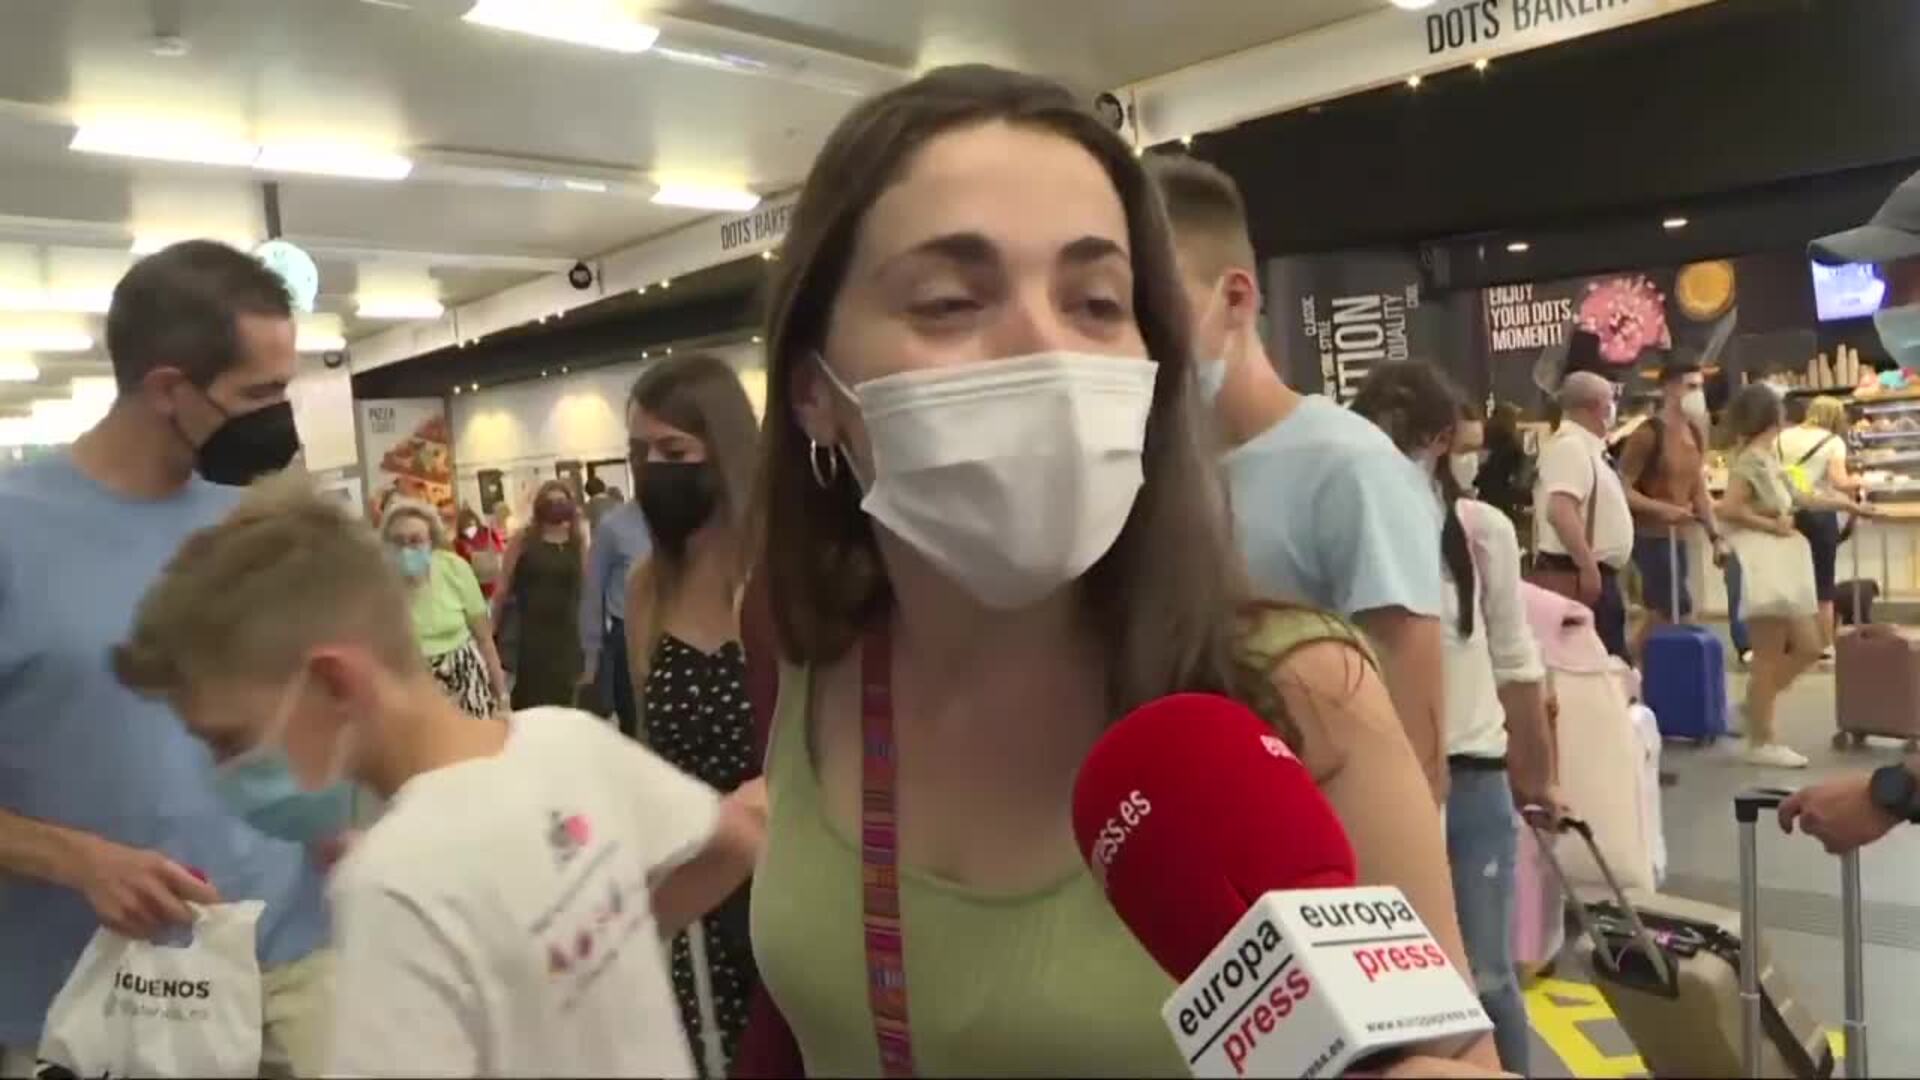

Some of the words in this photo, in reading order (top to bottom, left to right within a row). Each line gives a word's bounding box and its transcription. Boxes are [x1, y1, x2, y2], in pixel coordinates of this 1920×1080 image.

[1426, 0, 1500, 54] DOTS
[1513, 0, 1630, 31] BAK
[720, 216, 751, 250] DOTS
[1489, 283, 1533, 307] ENJOY
[1383, 293, 1409, 361] QUALITY
[1491, 303, 1531, 329] YOUR
[1532, 298, 1571, 324] DOTS
[1493, 323, 1563, 352] MOMENT!
[1299, 900, 1415, 930] europa
[1179, 919, 1282, 1036] europa
[1353, 943, 1446, 982] press
[1223, 968, 1310, 1075] press
